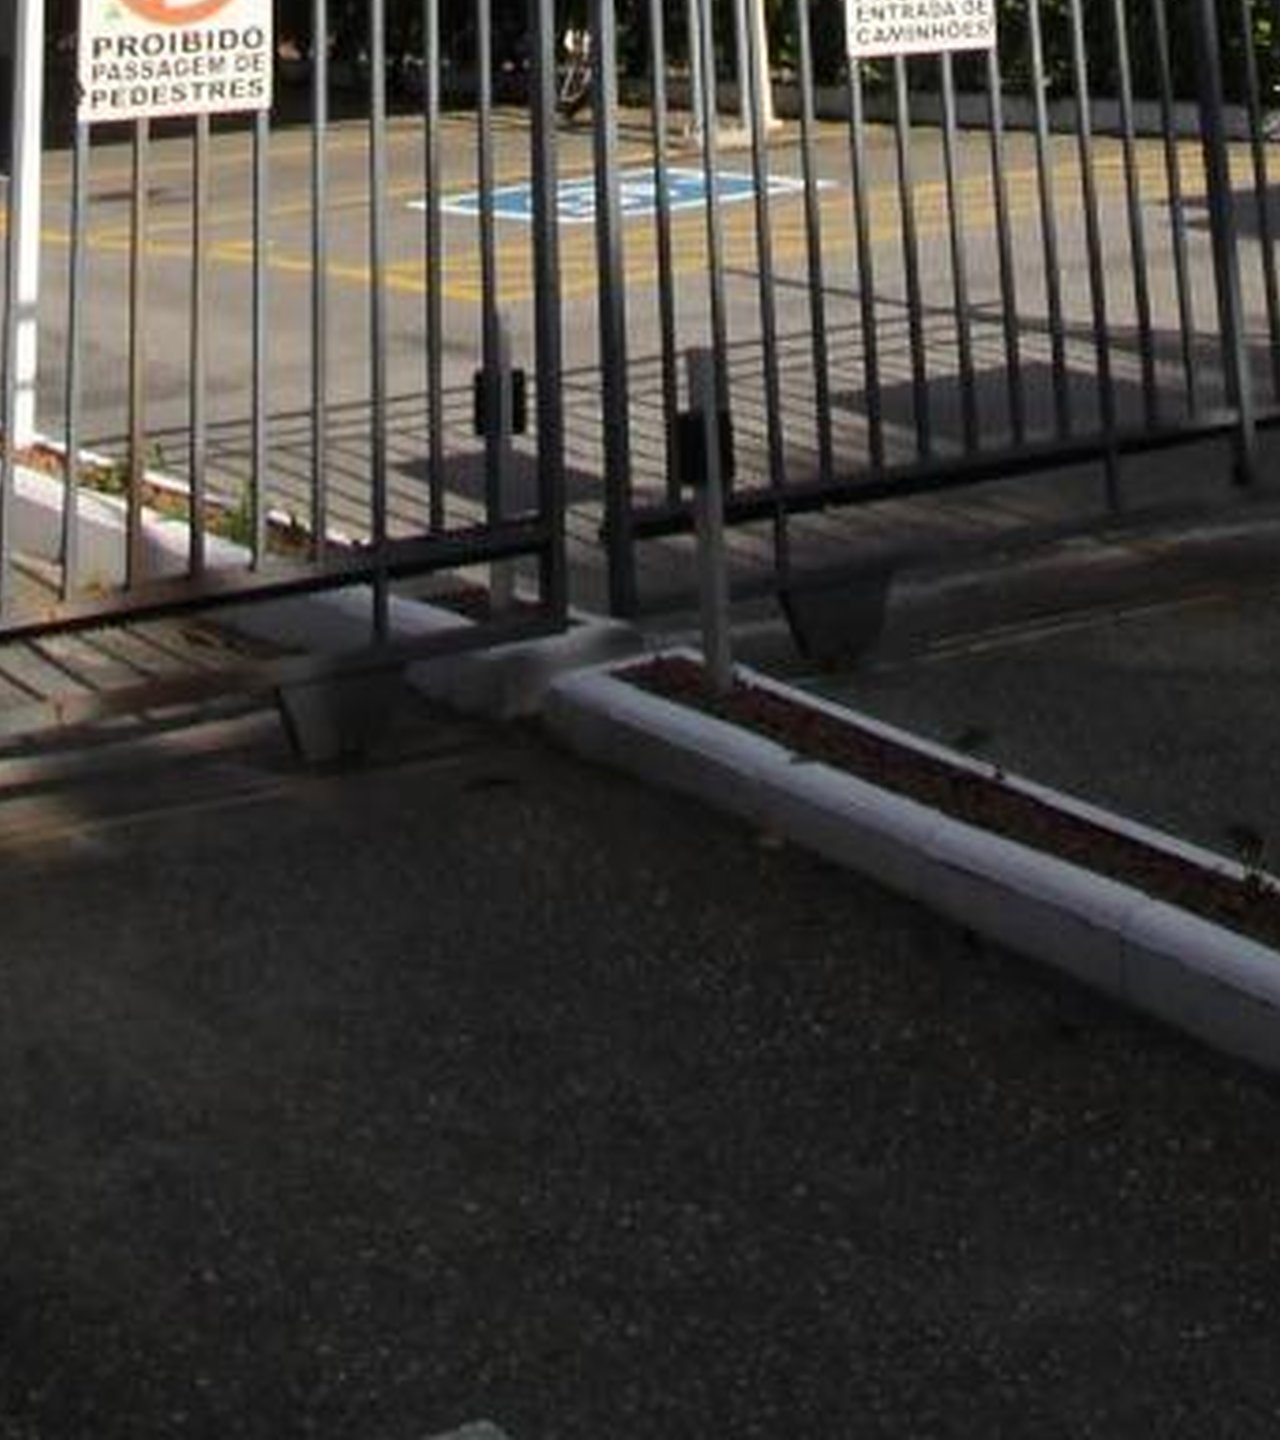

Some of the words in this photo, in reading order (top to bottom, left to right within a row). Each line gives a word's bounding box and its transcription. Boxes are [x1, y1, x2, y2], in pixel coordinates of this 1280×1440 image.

[856, 1, 956, 22] ENTRADA
[91, 26, 265, 59] PROIBIDO
[91, 54, 227, 82] PASSAGEM
[234, 52, 266, 72] DE
[90, 78, 265, 109] PEDESTRES
